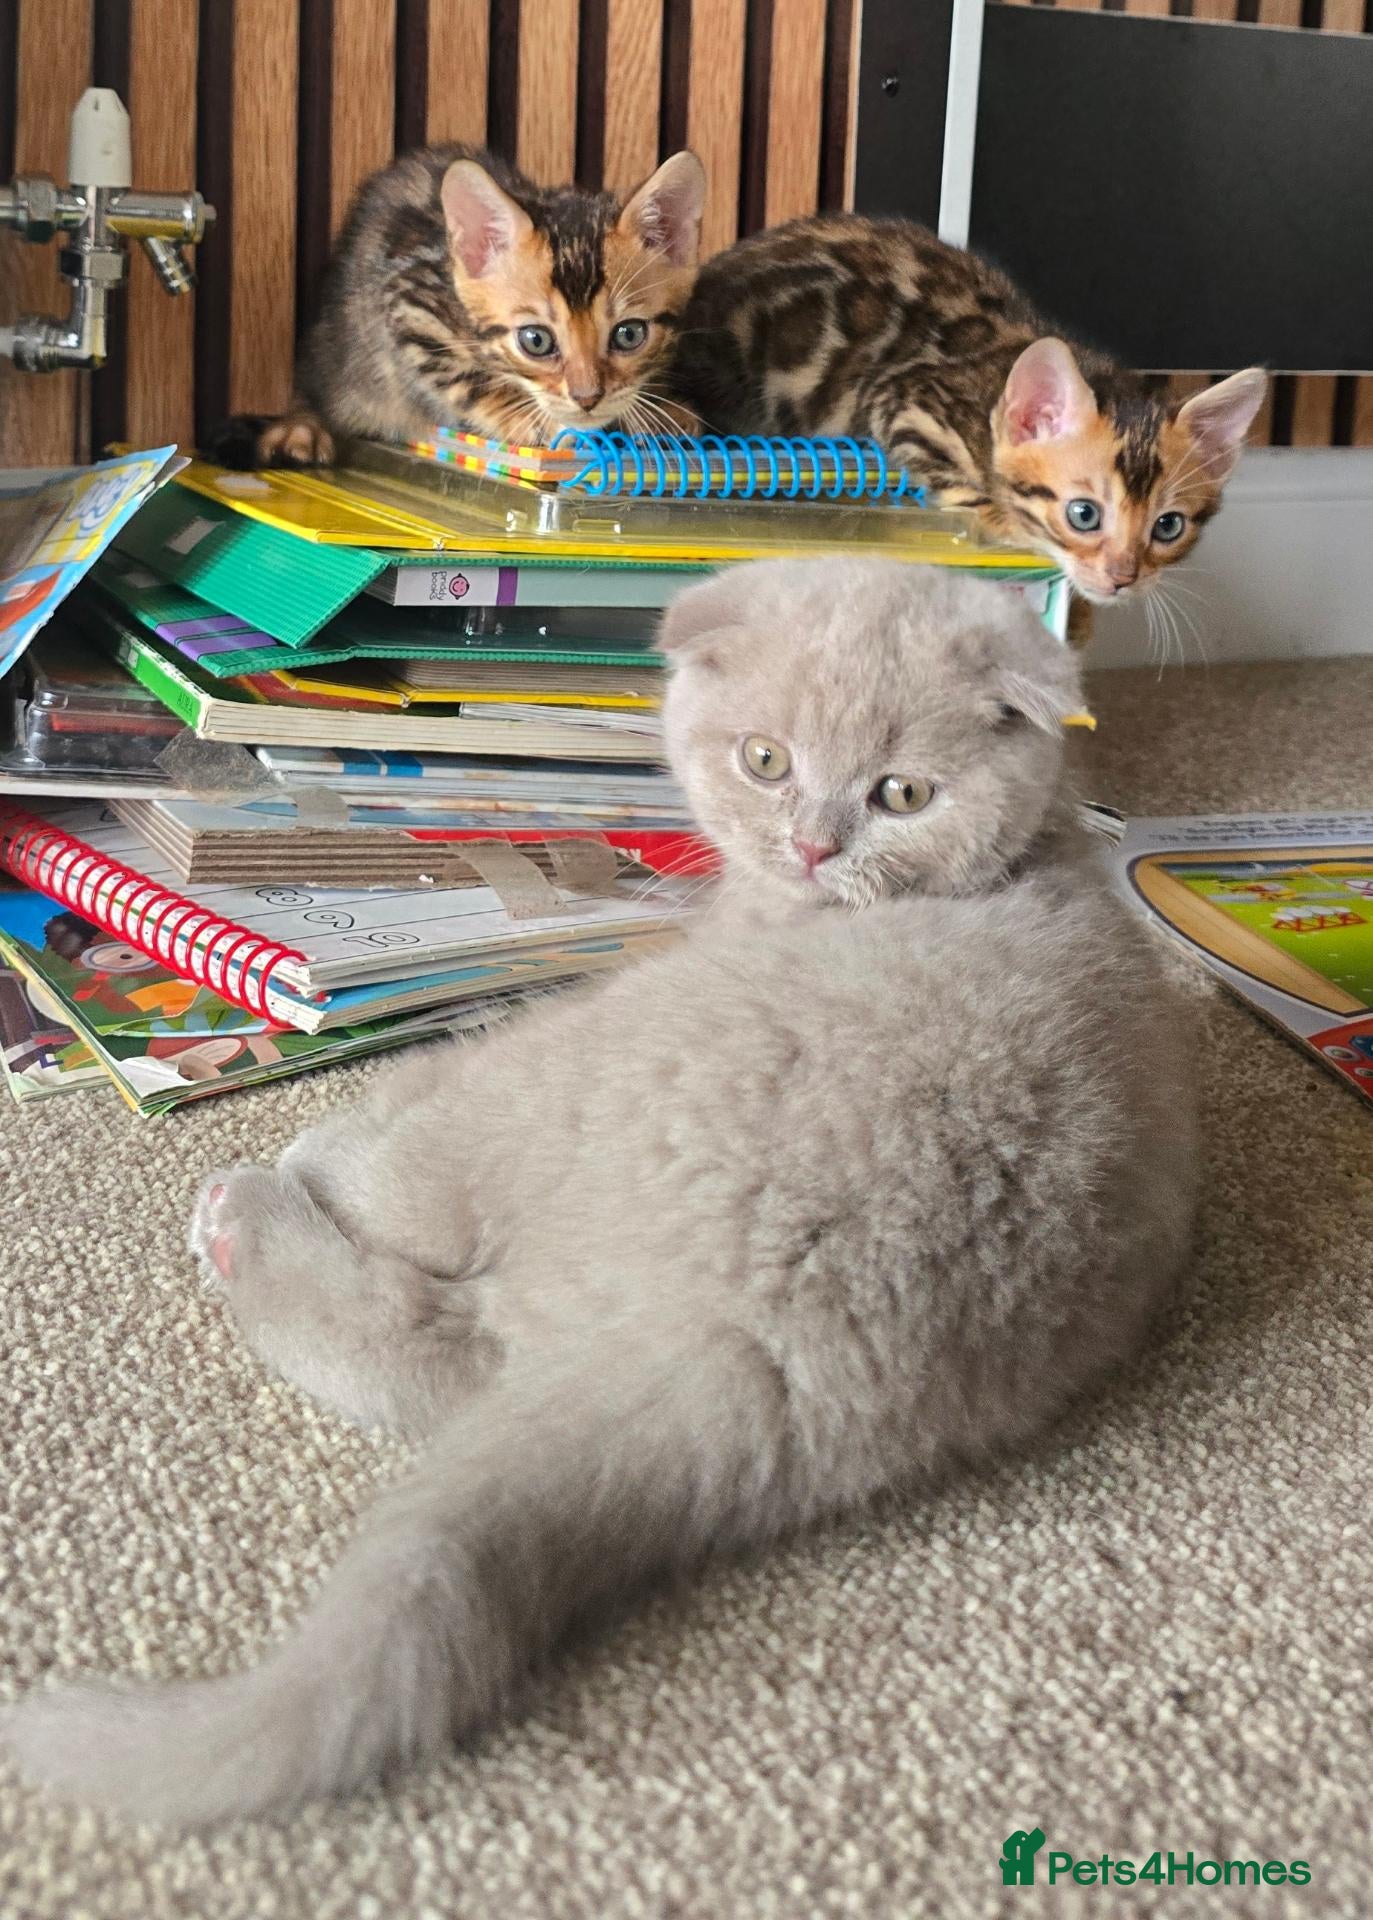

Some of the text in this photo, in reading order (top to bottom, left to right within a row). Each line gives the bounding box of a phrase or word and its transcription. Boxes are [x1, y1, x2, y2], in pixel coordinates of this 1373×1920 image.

[430, 572, 438, 600] books
[437, 571, 447, 600] priddy
[256, 887, 313, 906] 8
[304, 910, 354, 928] 9
[342, 932, 420, 948] 10
